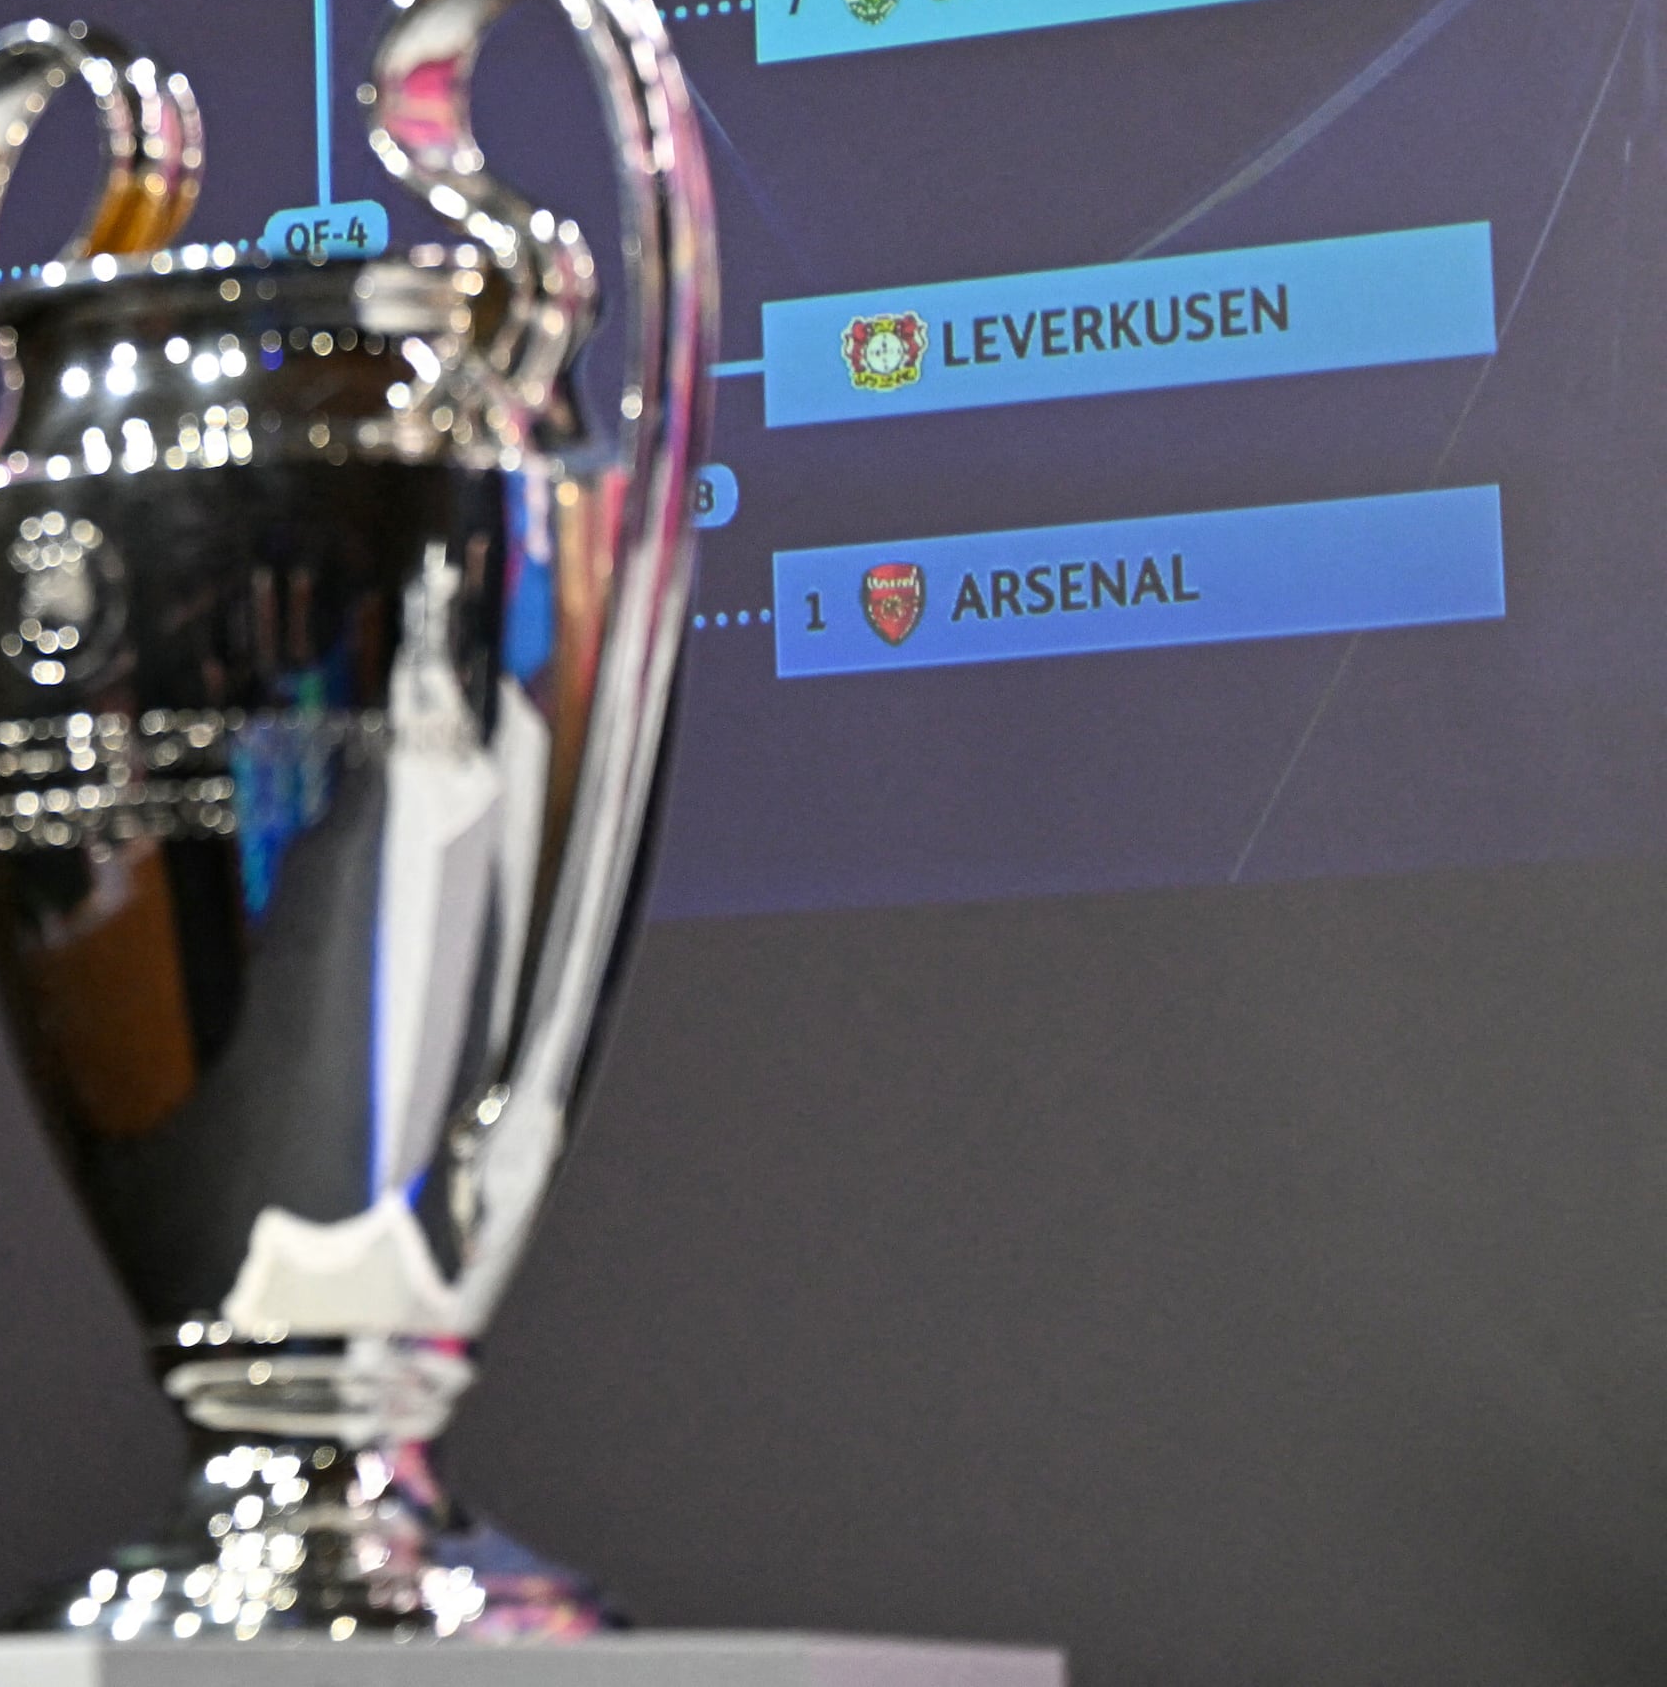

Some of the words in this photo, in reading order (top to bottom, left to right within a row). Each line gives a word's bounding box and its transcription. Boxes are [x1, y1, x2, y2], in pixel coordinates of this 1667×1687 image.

[943, 284, 1289, 368] LEVERKUSEN
[806, 593, 826, 632] 1
[951, 554, 1200, 622] ARSENAL
